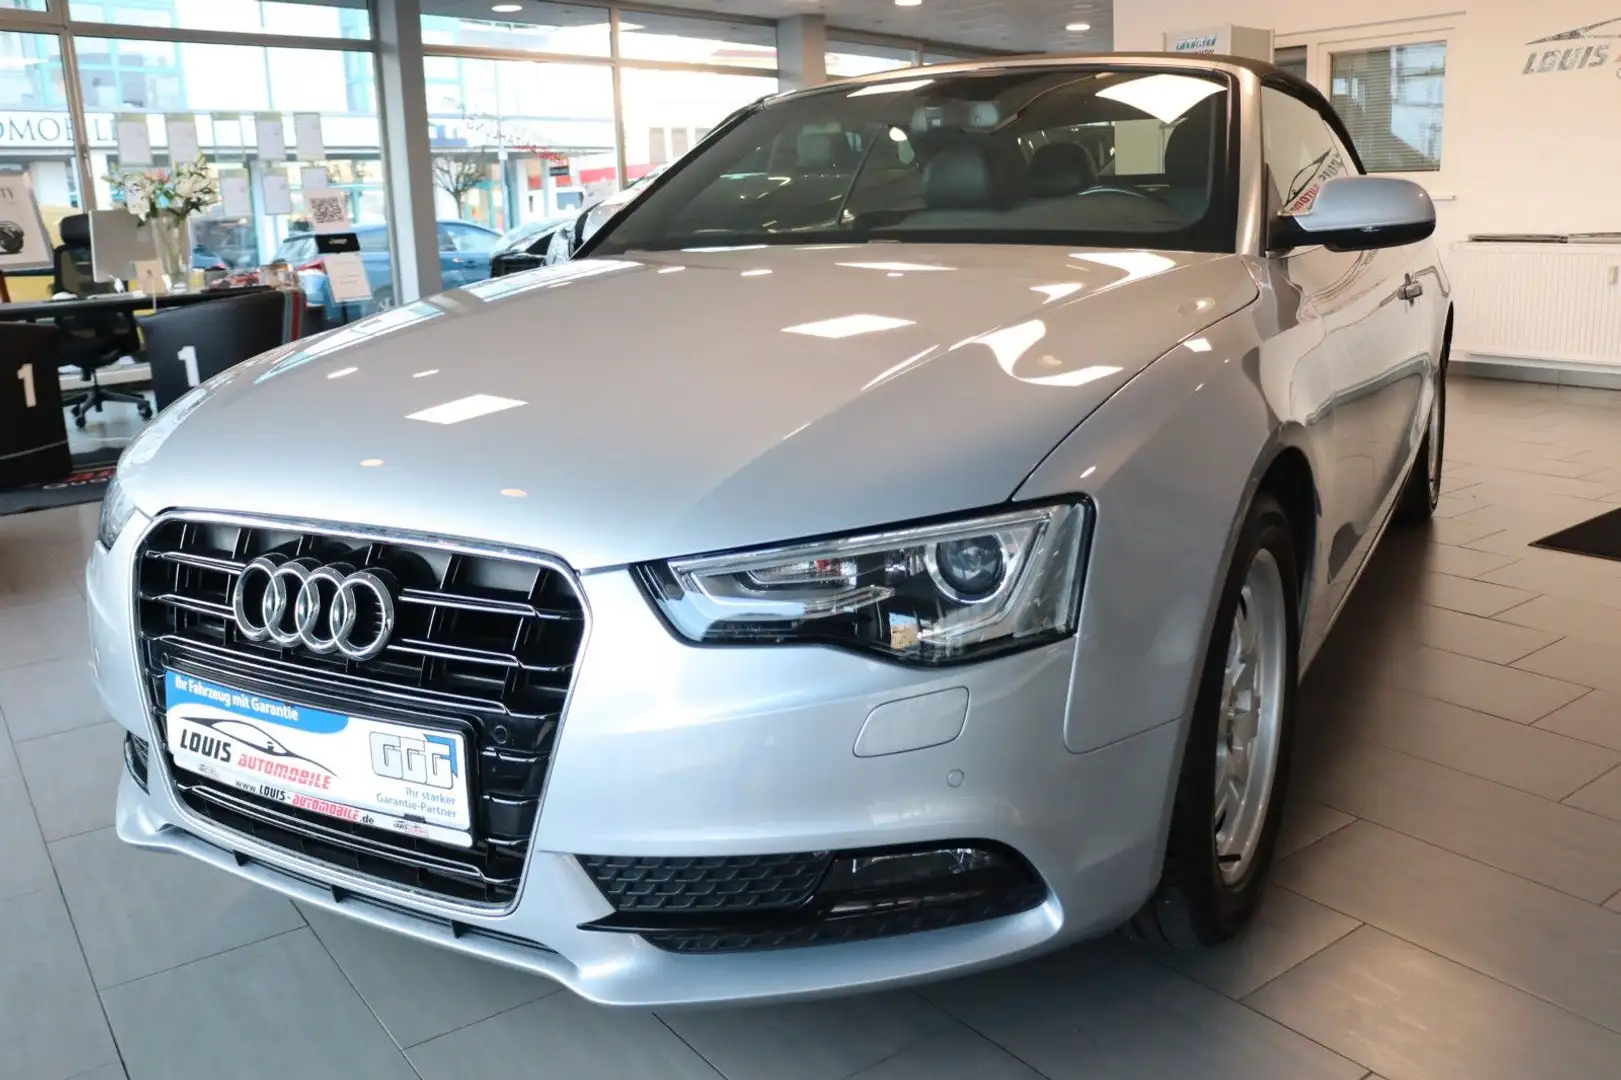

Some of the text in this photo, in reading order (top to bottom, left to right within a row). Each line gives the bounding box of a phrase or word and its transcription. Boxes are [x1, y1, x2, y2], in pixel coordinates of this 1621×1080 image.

[1521, 43, 1610, 76] LOUIS
[177, 346, 201, 387] 1
[17, 363, 37, 408] 1
[175, 674, 299, 721] Ihr Fahrzeug mit Garantie
[180, 728, 232, 763] LOUIS
[376, 793, 457, 818] Garantie-Partner
[405, 787, 456, 805] Ihr starker
